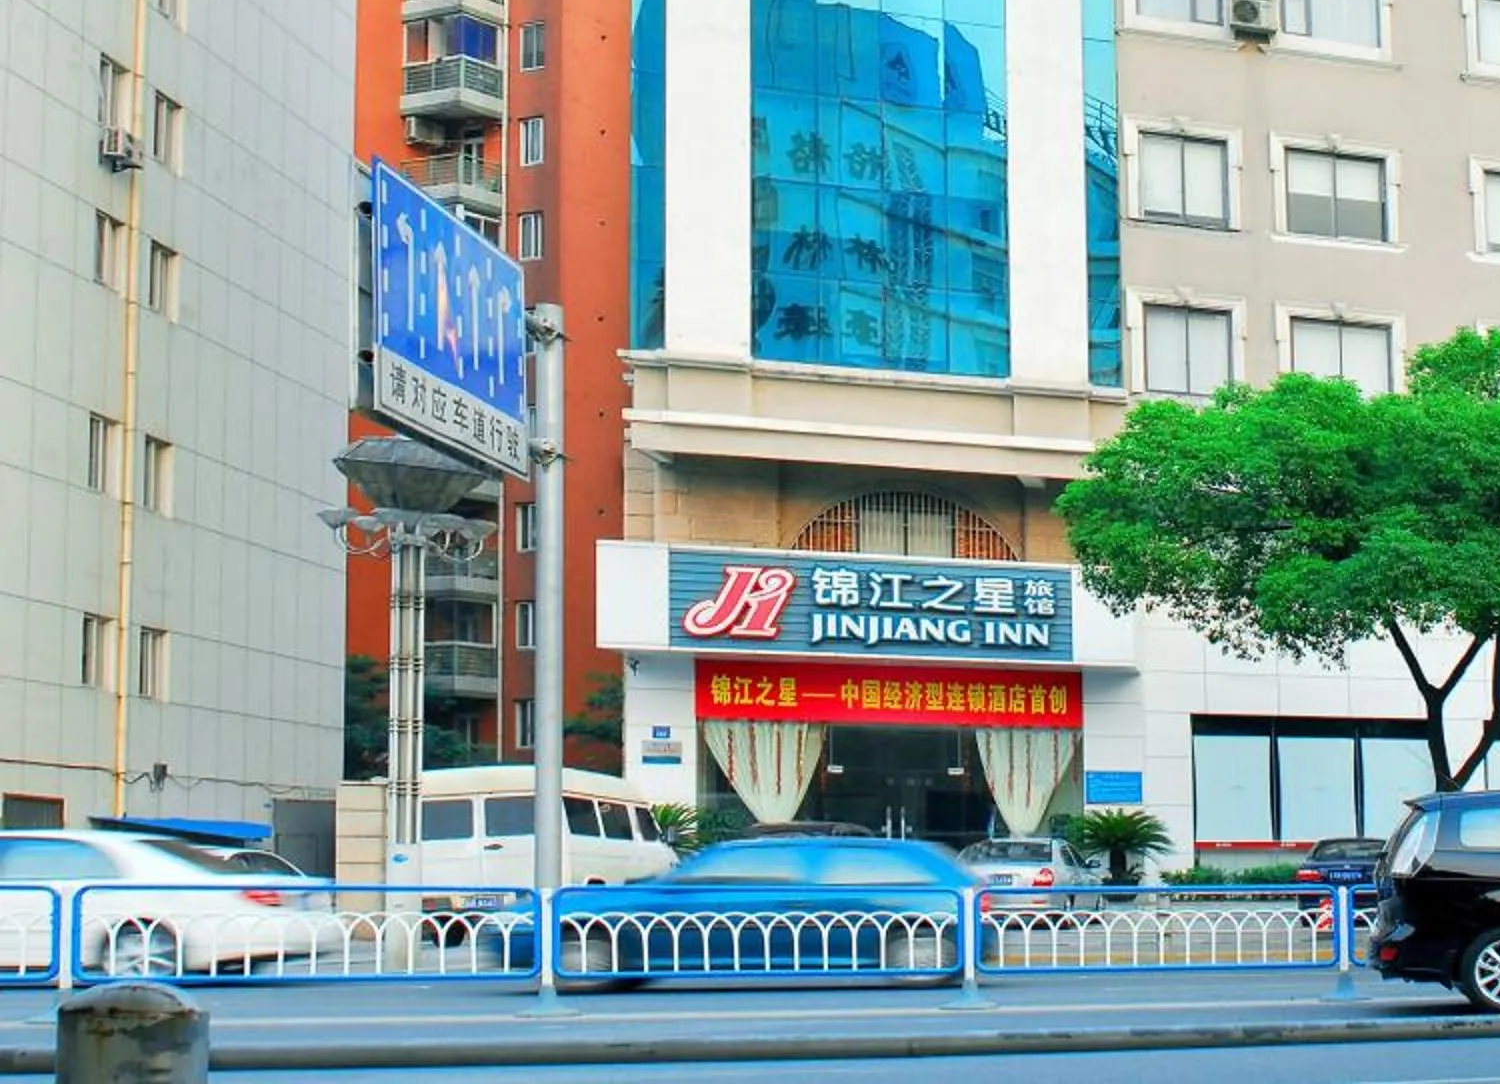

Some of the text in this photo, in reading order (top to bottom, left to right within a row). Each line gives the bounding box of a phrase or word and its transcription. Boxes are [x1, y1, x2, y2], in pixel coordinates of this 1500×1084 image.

[811, 567, 1017, 615] 锦江之星
[810, 613, 1050, 647] JINJIANG INN
